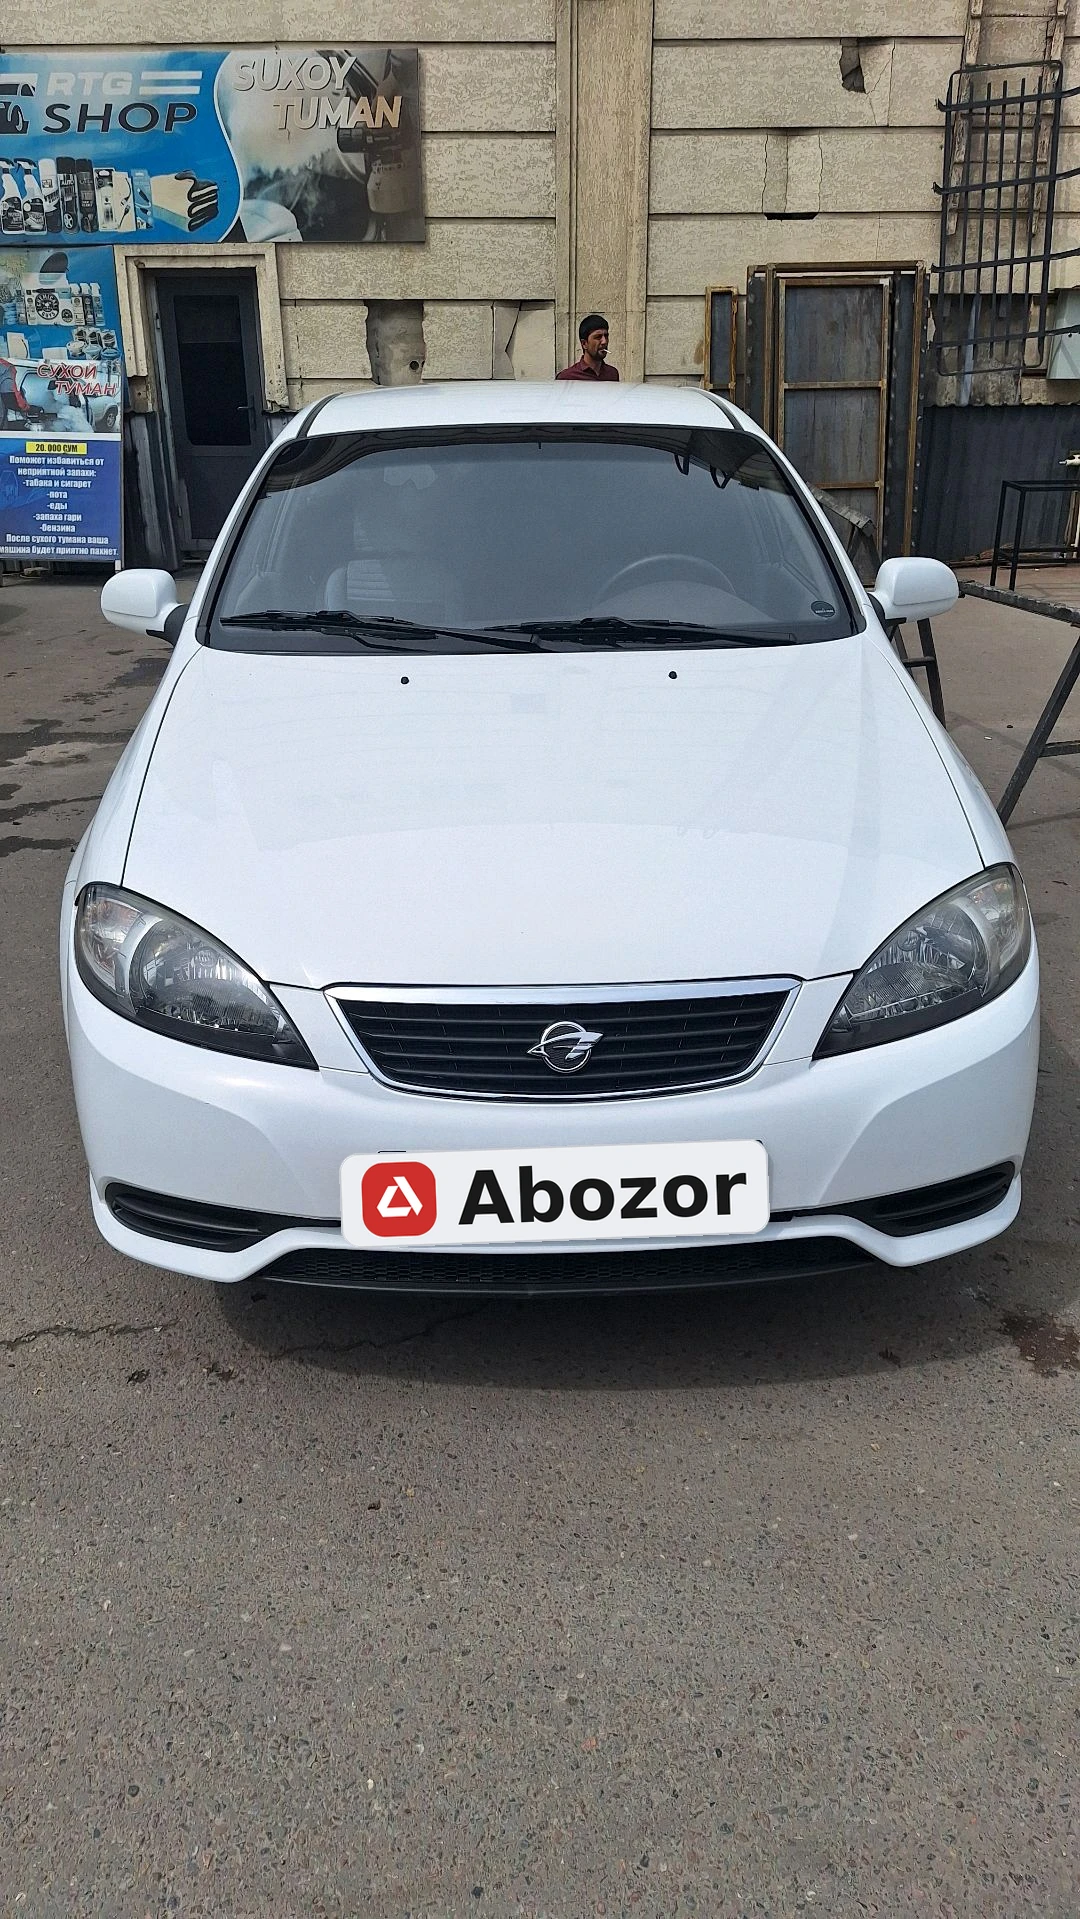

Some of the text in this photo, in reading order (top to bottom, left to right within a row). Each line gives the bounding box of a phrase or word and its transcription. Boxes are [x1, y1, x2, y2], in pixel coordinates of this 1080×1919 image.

[232, 56, 358, 91] SUXOY
[46, 71, 133, 97] RTG
[42, 102, 197, 134] SHOP
[273, 95, 402, 130] TUMAN
[37, 362, 97, 379] СУХОЙ
[55, 381, 117, 396] ТУМАН
[63, 444, 78, 453] СУМ
[9, 455, 104, 466] Поможет избавиться от
[17, 467, 65, 477] неприятной
[60, 480, 92, 489] сигарет
[46, 491, 68, 499] -пота
[46, 502, 68, 510] -еды
[64, 514, 82, 522] гари
[39, 523, 76, 533] -бензина
[6, 533, 109, 544] После сухого тумана ваша
[31, 545, 55, 555] будет
[56, 546, 89, 555] приятно
[90, 547, 119, 556] пахнет.
